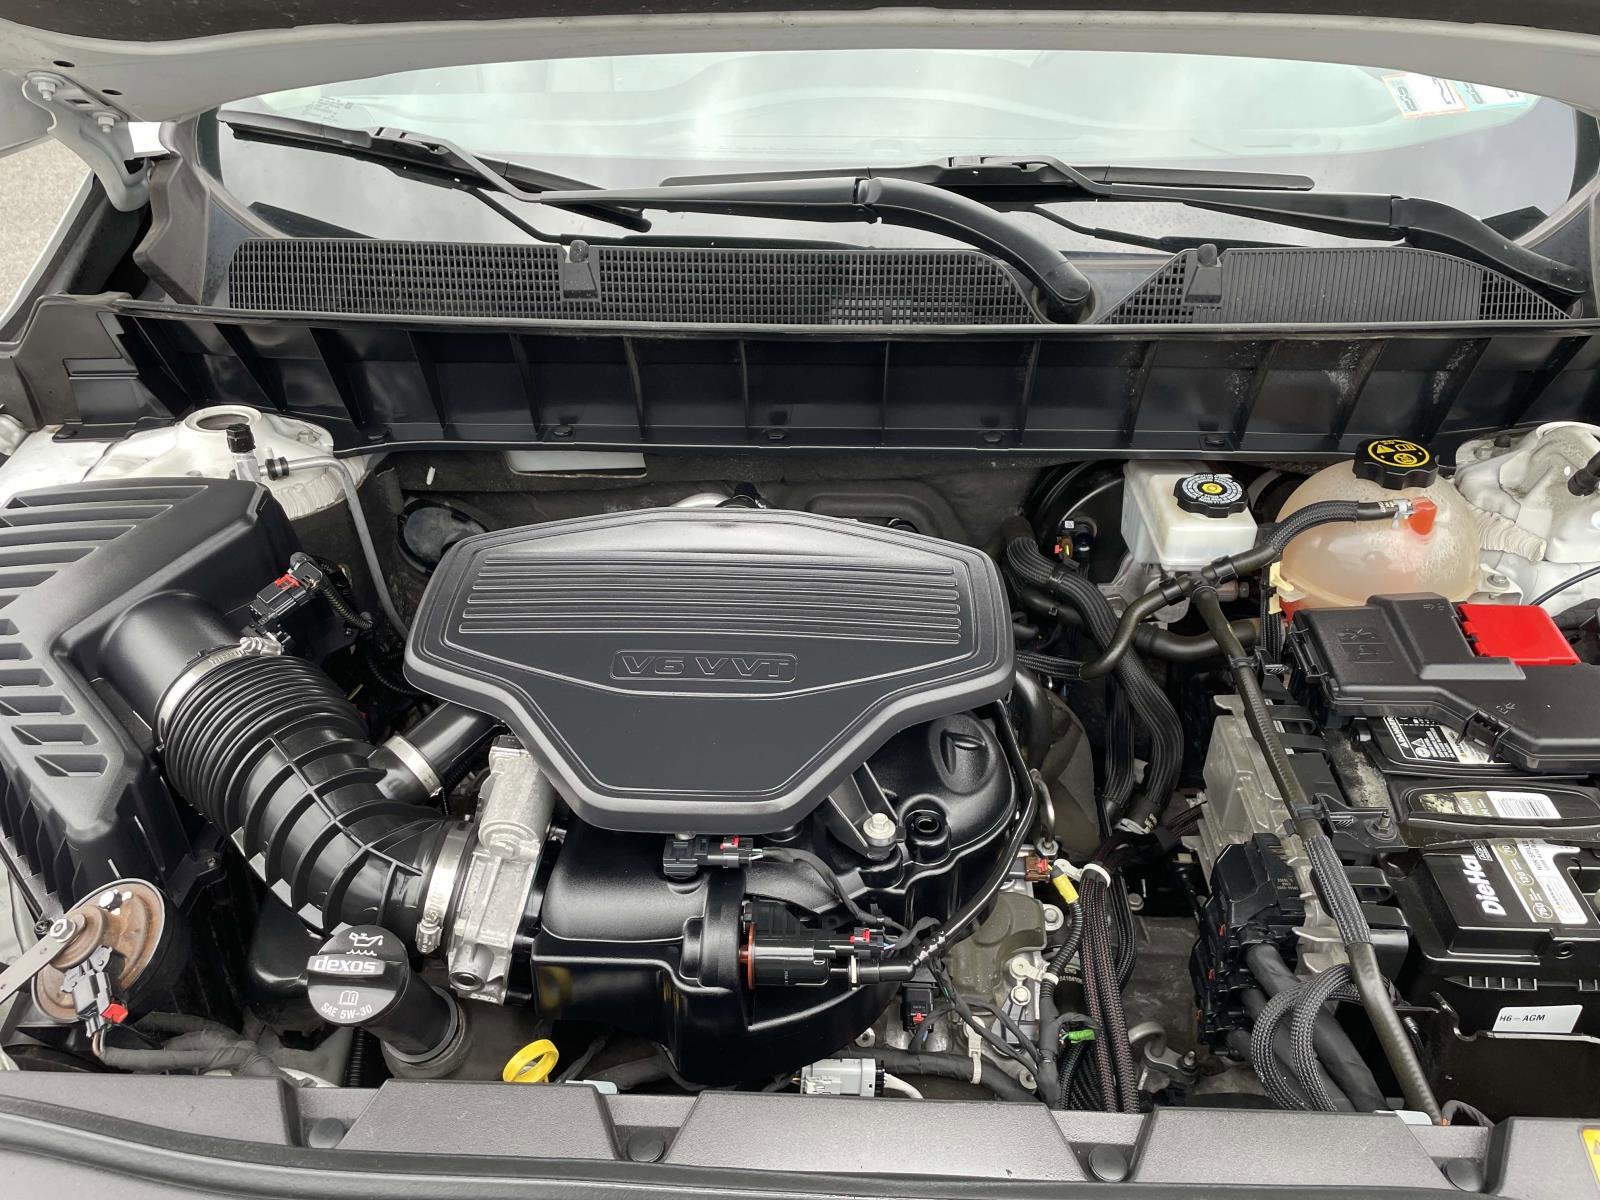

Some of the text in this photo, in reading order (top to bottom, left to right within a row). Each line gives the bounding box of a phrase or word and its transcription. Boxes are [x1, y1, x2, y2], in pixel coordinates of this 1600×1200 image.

[622, 655, 790, 678] V6 VVT
[314, 956, 377, 973] dexos
[321, 1002, 373, 1020] SAE 5W-30
